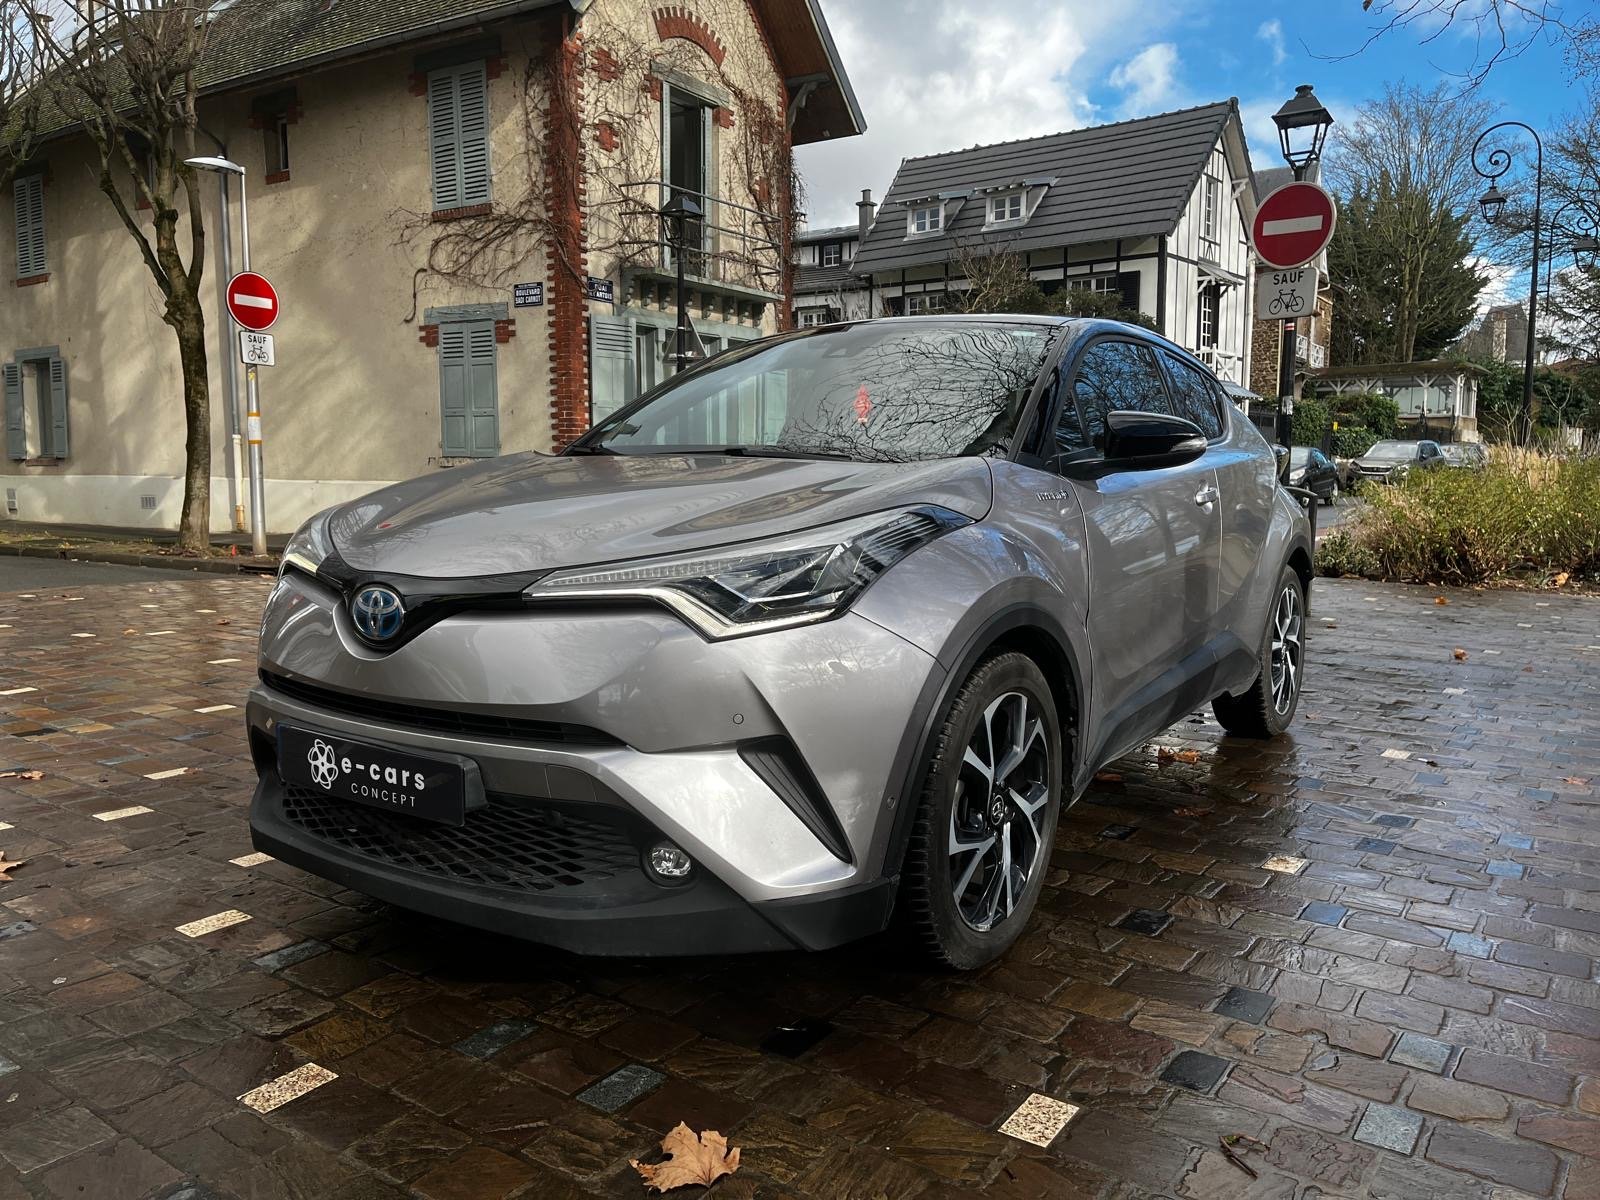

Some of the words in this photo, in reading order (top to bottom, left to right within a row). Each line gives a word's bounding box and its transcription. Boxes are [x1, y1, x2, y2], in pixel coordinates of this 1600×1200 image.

[1273, 270, 1304, 285] SAUF
[515, 288, 541, 296] BOULEVARD
[525, 295, 541, 303] CARNOT
[247, 334, 267, 344] SAUF
[341, 757, 425, 790] e-cars
[351, 783, 415, 807] CONCEPT
